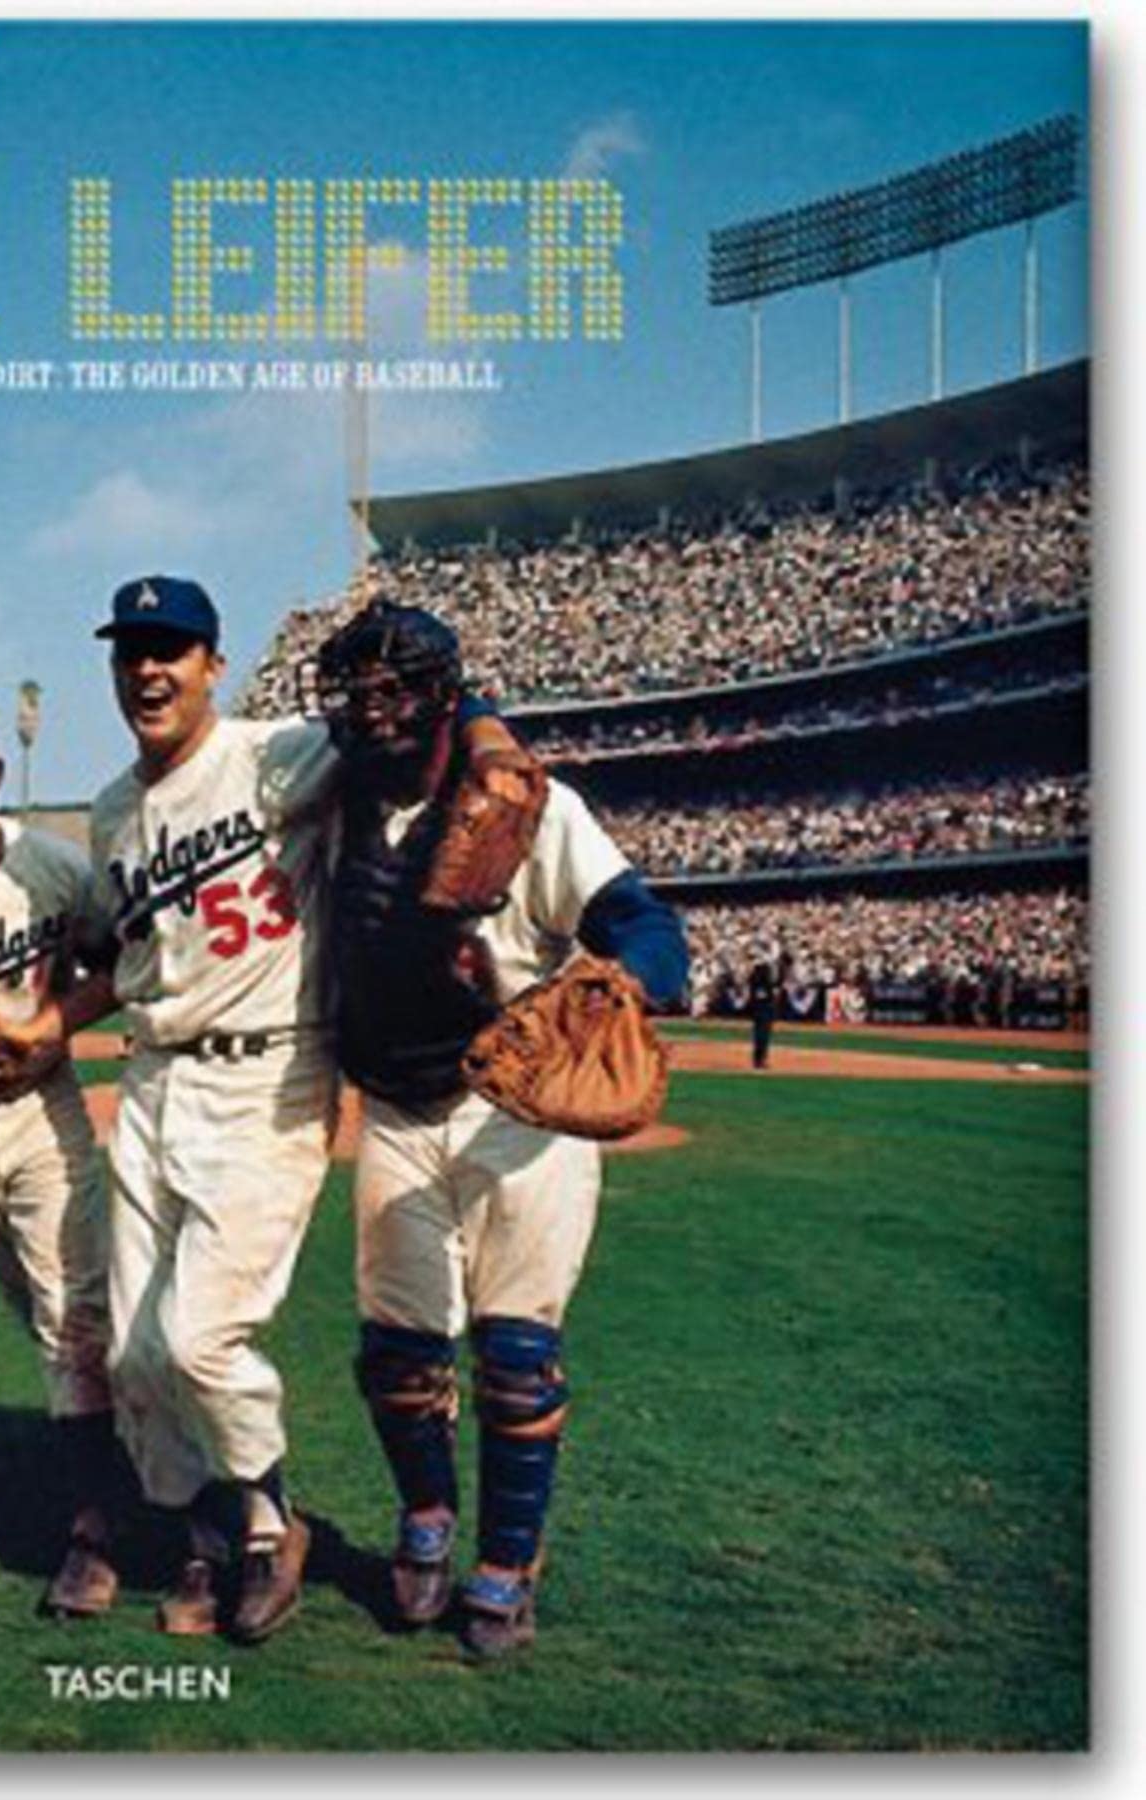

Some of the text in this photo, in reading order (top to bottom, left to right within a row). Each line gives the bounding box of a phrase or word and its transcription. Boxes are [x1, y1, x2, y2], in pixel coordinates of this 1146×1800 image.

[70, 178, 625, 341] LEIFER
[69, 360, 126, 390] THE
[131, 360, 246, 390] GOLDEN
[253, 360, 305, 390] AGE
[313, 360, 353, 390] OF
[356, 360, 501, 390] BASEBALL
[198, 866, 298, 959] 53
[44, 1664, 232, 1701] TASCHEN
